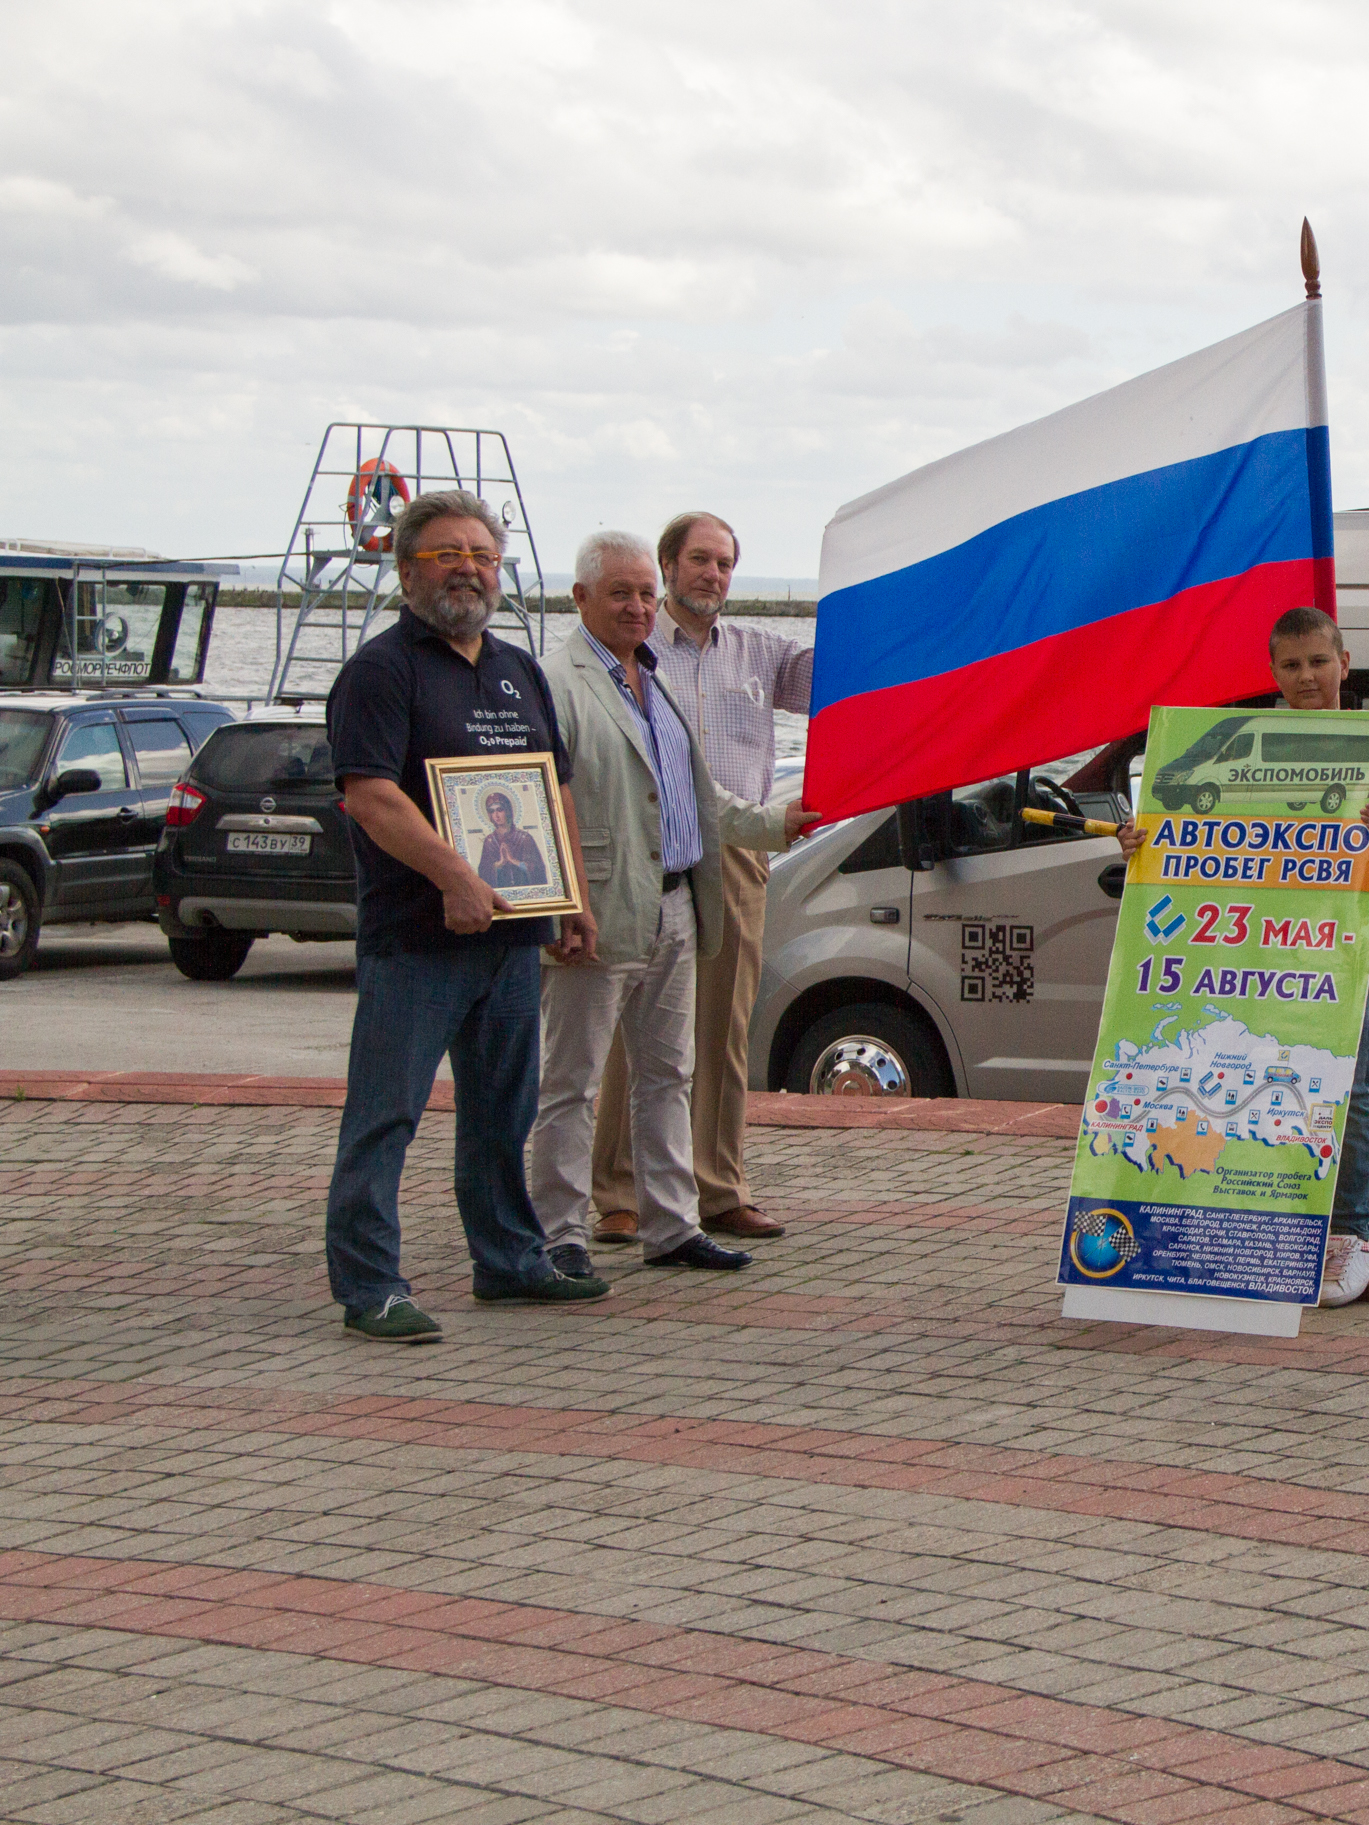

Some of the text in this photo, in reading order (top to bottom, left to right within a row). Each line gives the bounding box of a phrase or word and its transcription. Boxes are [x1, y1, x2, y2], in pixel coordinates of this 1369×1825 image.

[473, 709, 519, 719] Ich bin ohne
[466, 723, 493, 734] Bindung
[505, 723, 530, 733] haben
[495, 736, 527, 747] Prepaid
[1228, 767, 1366, 784] ЭКСПОМОБИЛЬ
[1162, 855, 1353, 884] ПРОБЕГ РСВЯ
[1190, 903, 1254, 947] 23
[1137, 956, 1339, 1001] 15 АВГУСТА
[1213, 1052, 1248, 1061] Нижний
[1103, 1060, 1180, 1073] Санкт-Петербург
[1210, 1061, 1252, 1070] Новгород
[1142, 1101, 1173, 1110] Москва
[1266, 1107, 1305, 1117] Иркутск
[1090, 1121, 1144, 1132] КАЛИНИНГРАД
[1276, 1135, 1327, 1143] ВЛАДИВОСТОК
[1216, 1166, 1312, 1181] Организатор пробега
[1220, 1176, 1301, 1190] Российский Союз
[1213, 1185, 1257, 1196] Выставок
[1269, 1189, 1308, 1200] Ярмарок
[1139, 1205, 1204, 1218] КАЛИНИНГРАД,
[1150, 1215, 1180, 1225] МОСКВА,
[1203, 1245, 1234, 1254] НИЖНИЙ
[1248, 1281, 1315, 1295] ВЛАДИВОСТОК
